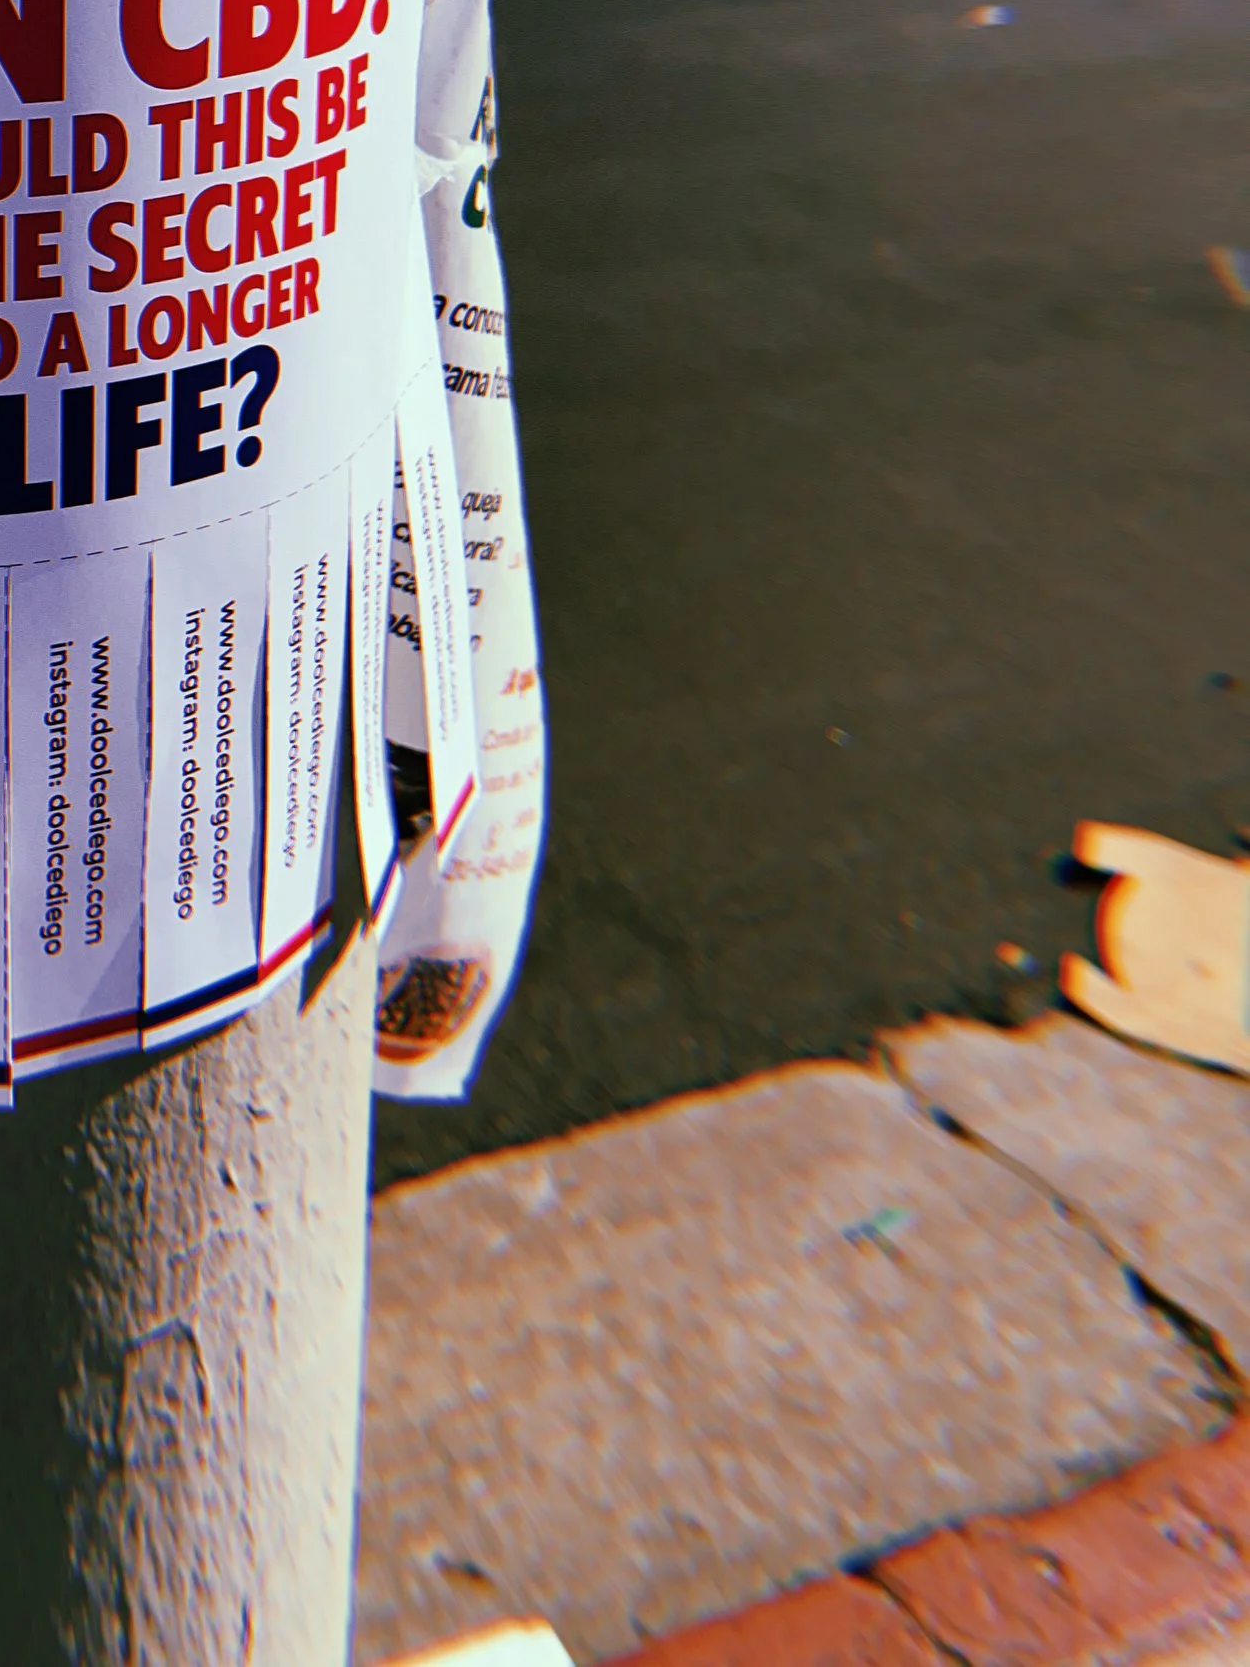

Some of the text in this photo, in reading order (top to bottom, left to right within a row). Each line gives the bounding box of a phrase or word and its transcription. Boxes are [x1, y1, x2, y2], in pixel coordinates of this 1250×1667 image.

[87, 148, 347, 295] SECRET
[148, 78, 299, 182] THIS
[315, 53, 370, 145] BE
[38, 312, 89, 378] A
[107, 256, 320, 365] LONGER
[40, 641, 73, 955] instagram: doolcediego
[83, 635, 110, 945] www.doolcediego.com
[174, 608, 205, 921] instagram: doolcediego
[210, 601, 237, 906] www.doolcediego.com
